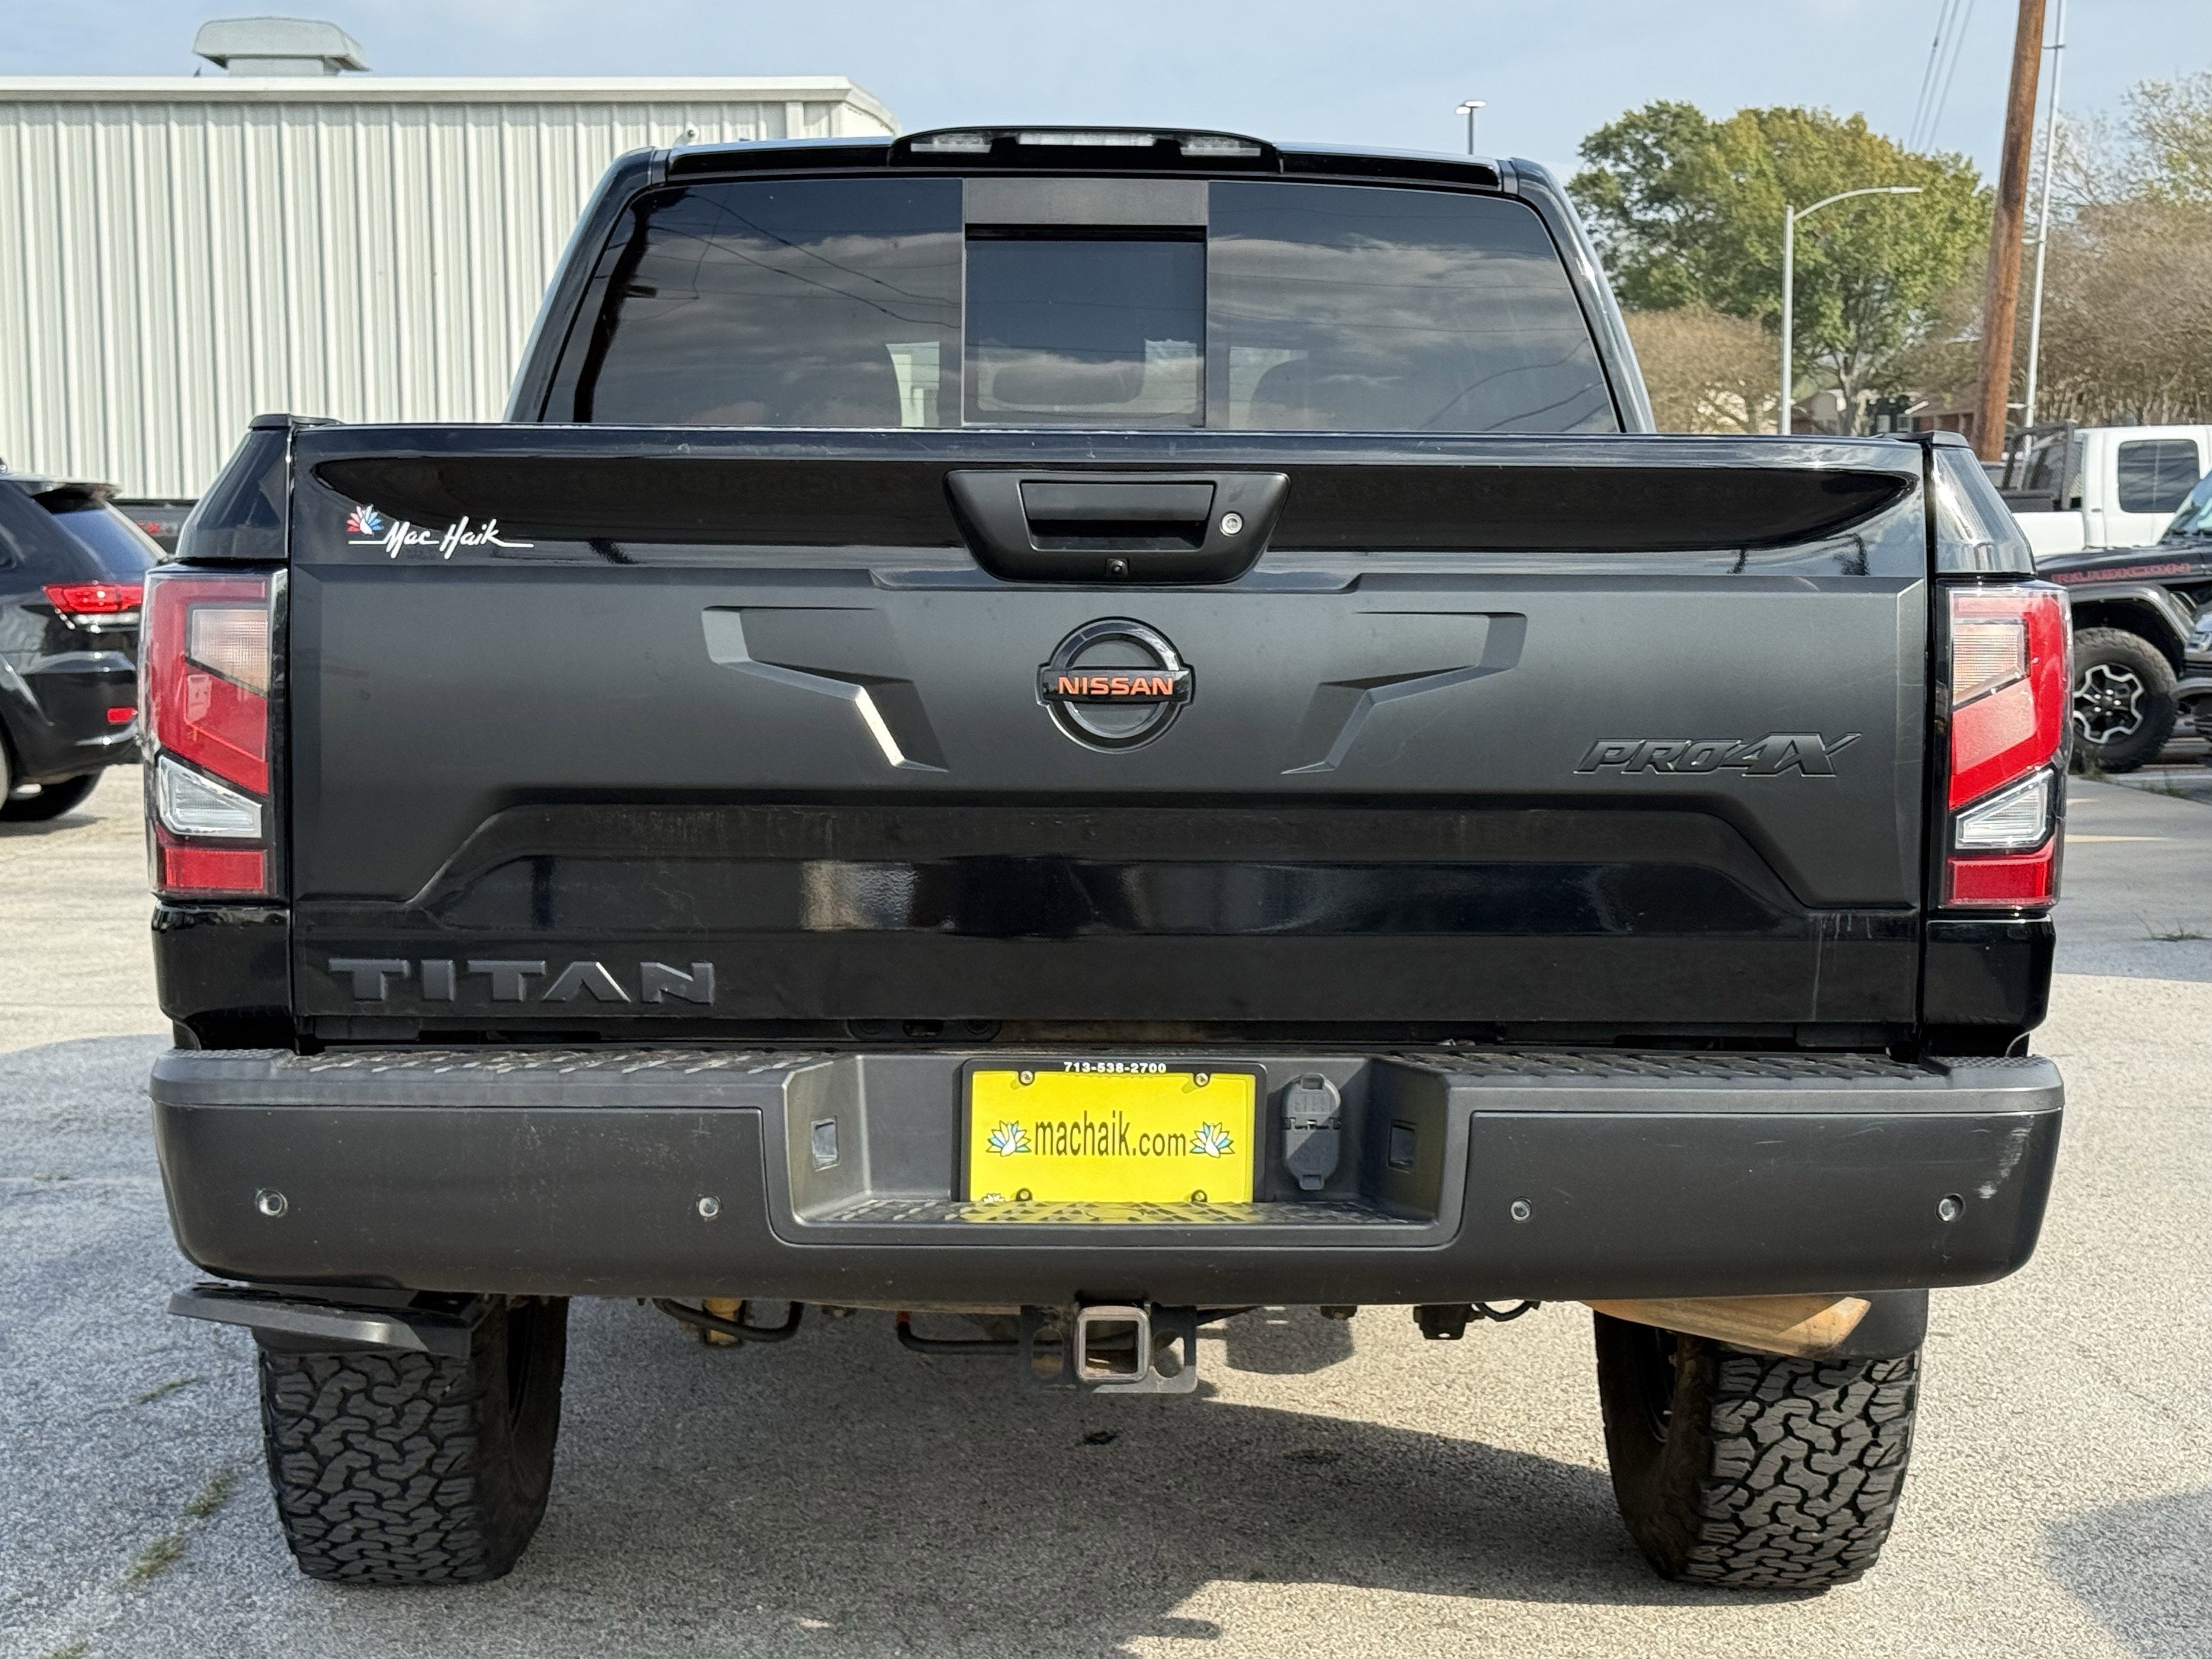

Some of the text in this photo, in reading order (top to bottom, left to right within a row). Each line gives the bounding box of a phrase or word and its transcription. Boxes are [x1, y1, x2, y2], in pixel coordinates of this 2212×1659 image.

[385, 516, 502, 560] Mac Haik
[2051, 562, 2191, 584] RUBICON
[1057, 676, 1174, 696] NISSAN
[1573, 731, 1862, 777] PRO4X
[329, 958, 714, 1003] TITAN
[1063, 1061, 1167, 1073] 713-538-2700
[1035, 1110, 1186, 1156] machaik.com
